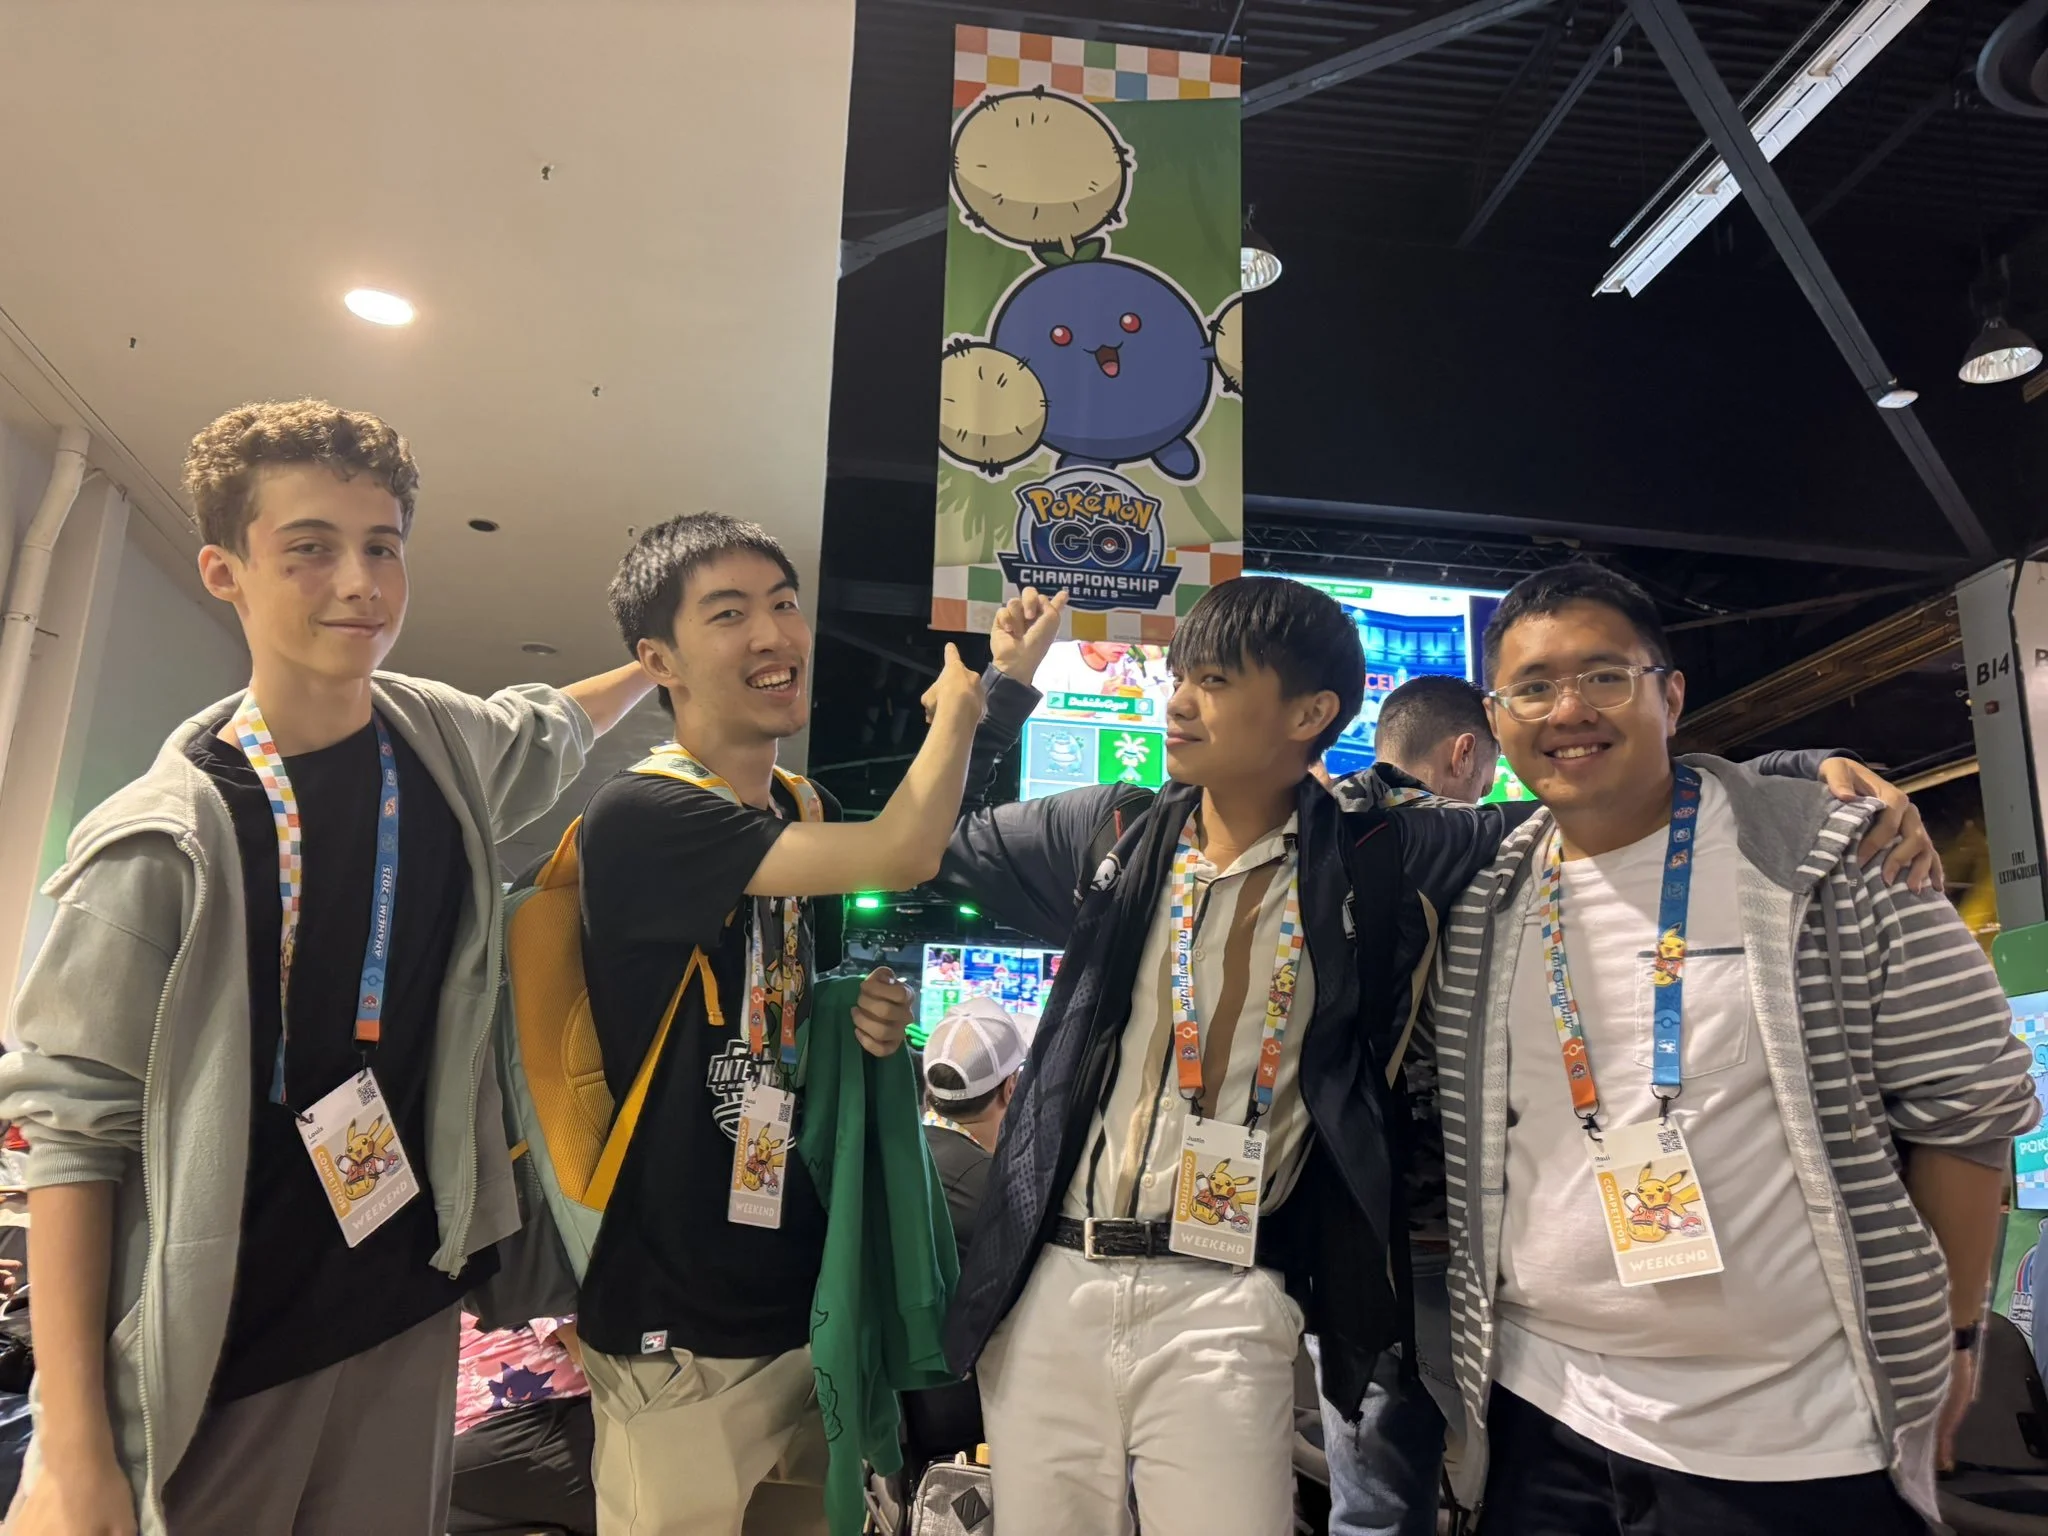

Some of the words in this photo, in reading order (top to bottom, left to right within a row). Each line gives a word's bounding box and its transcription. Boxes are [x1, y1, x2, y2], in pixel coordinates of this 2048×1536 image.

[1027, 484, 1156, 531] Pokémon
[1049, 522, 1132, 567] GO
[1019, 568, 1160, 593] CHAMPIONSHIP
[1976, 652, 2010, 686] B14
[2011, 850, 2026, 866] FIRE
[373, 905, 388, 959] ANAHEIM
[381, 864, 392, 895] 2025
[2019, 1137, 2048, 1155] POK
[316, 1151, 346, 1210] COMPETITOR
[1178, 1156, 1193, 1217] COMPETITOR
[352, 1180, 408, 1231] WEEKEND
[736, 1202, 775, 1218] WEEKEND
[1602, 1178, 1627, 1245] COMPETITOR
[1180, 1232, 1245, 1255] WEEKEND
[1628, 1250, 1709, 1272] WEEKEND
